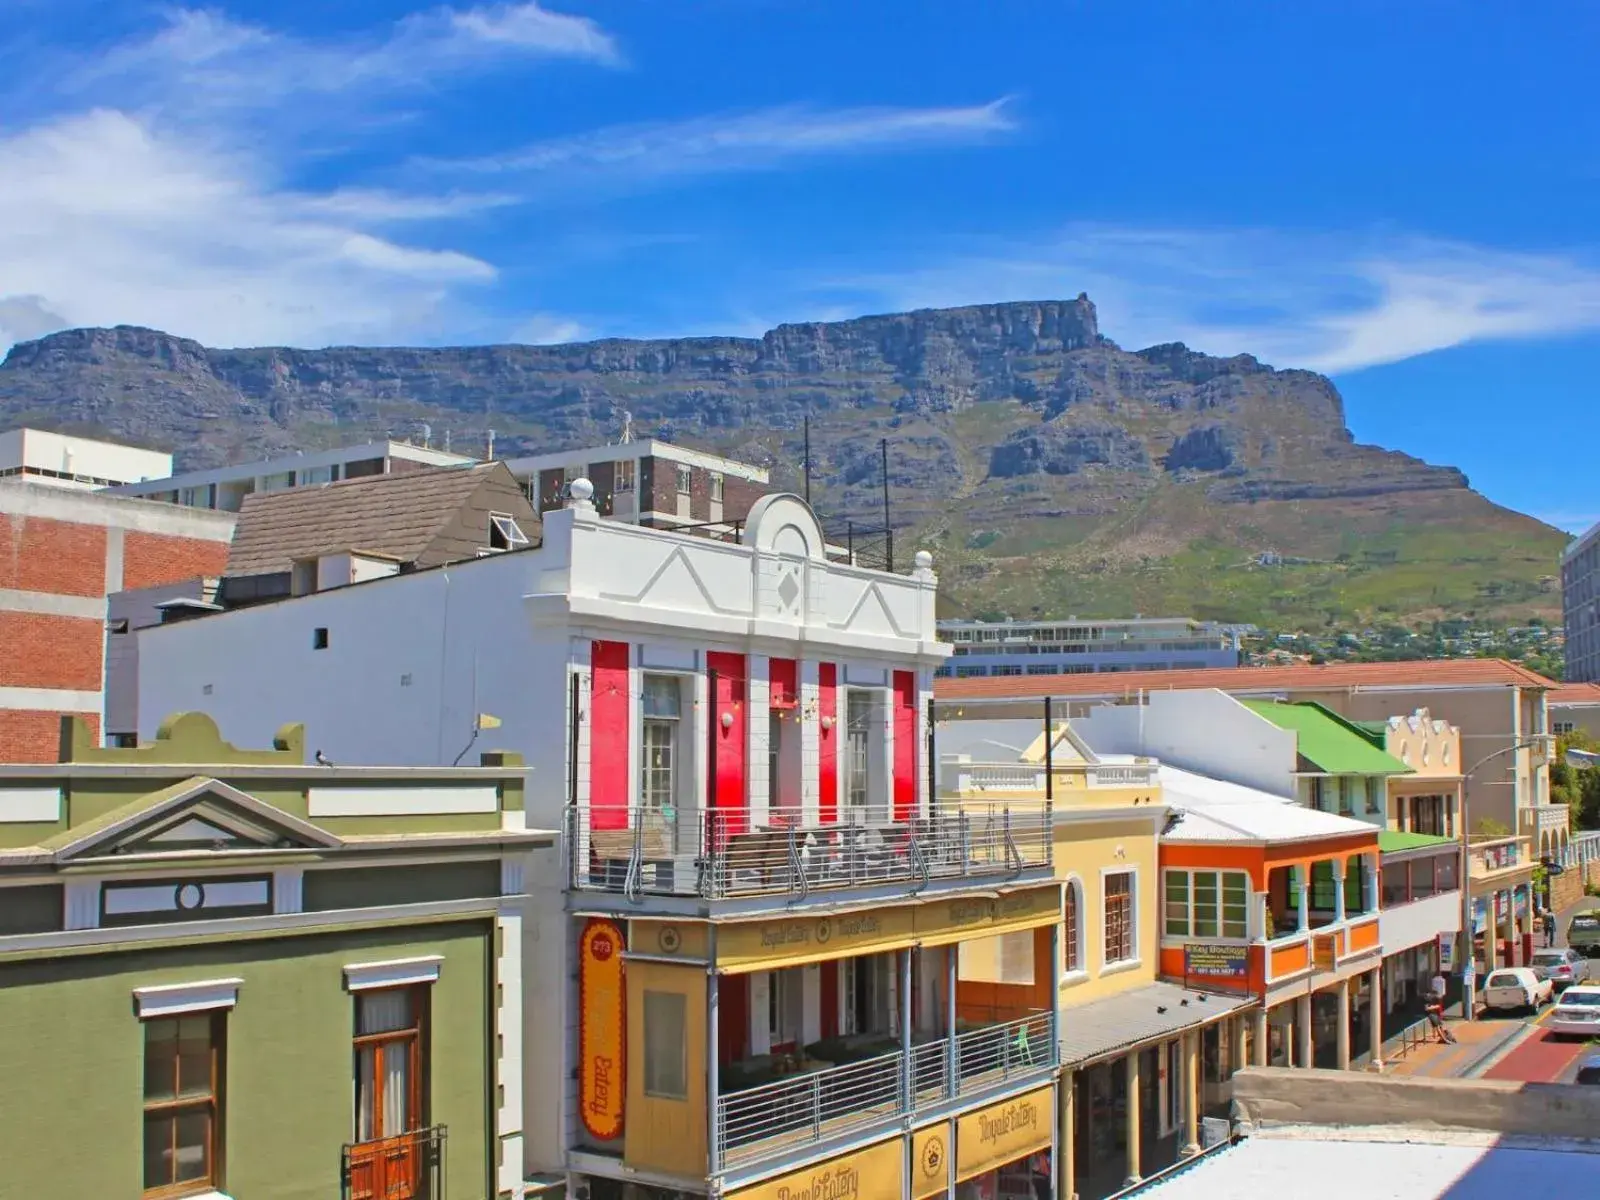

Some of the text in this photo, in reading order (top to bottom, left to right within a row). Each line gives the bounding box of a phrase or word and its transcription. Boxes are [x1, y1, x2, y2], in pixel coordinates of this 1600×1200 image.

[589, 1055, 613, 1117] Eatery
[978, 1101, 1037, 1146] Royale Eatery
[818, 1167, 859, 1200] Eatery
